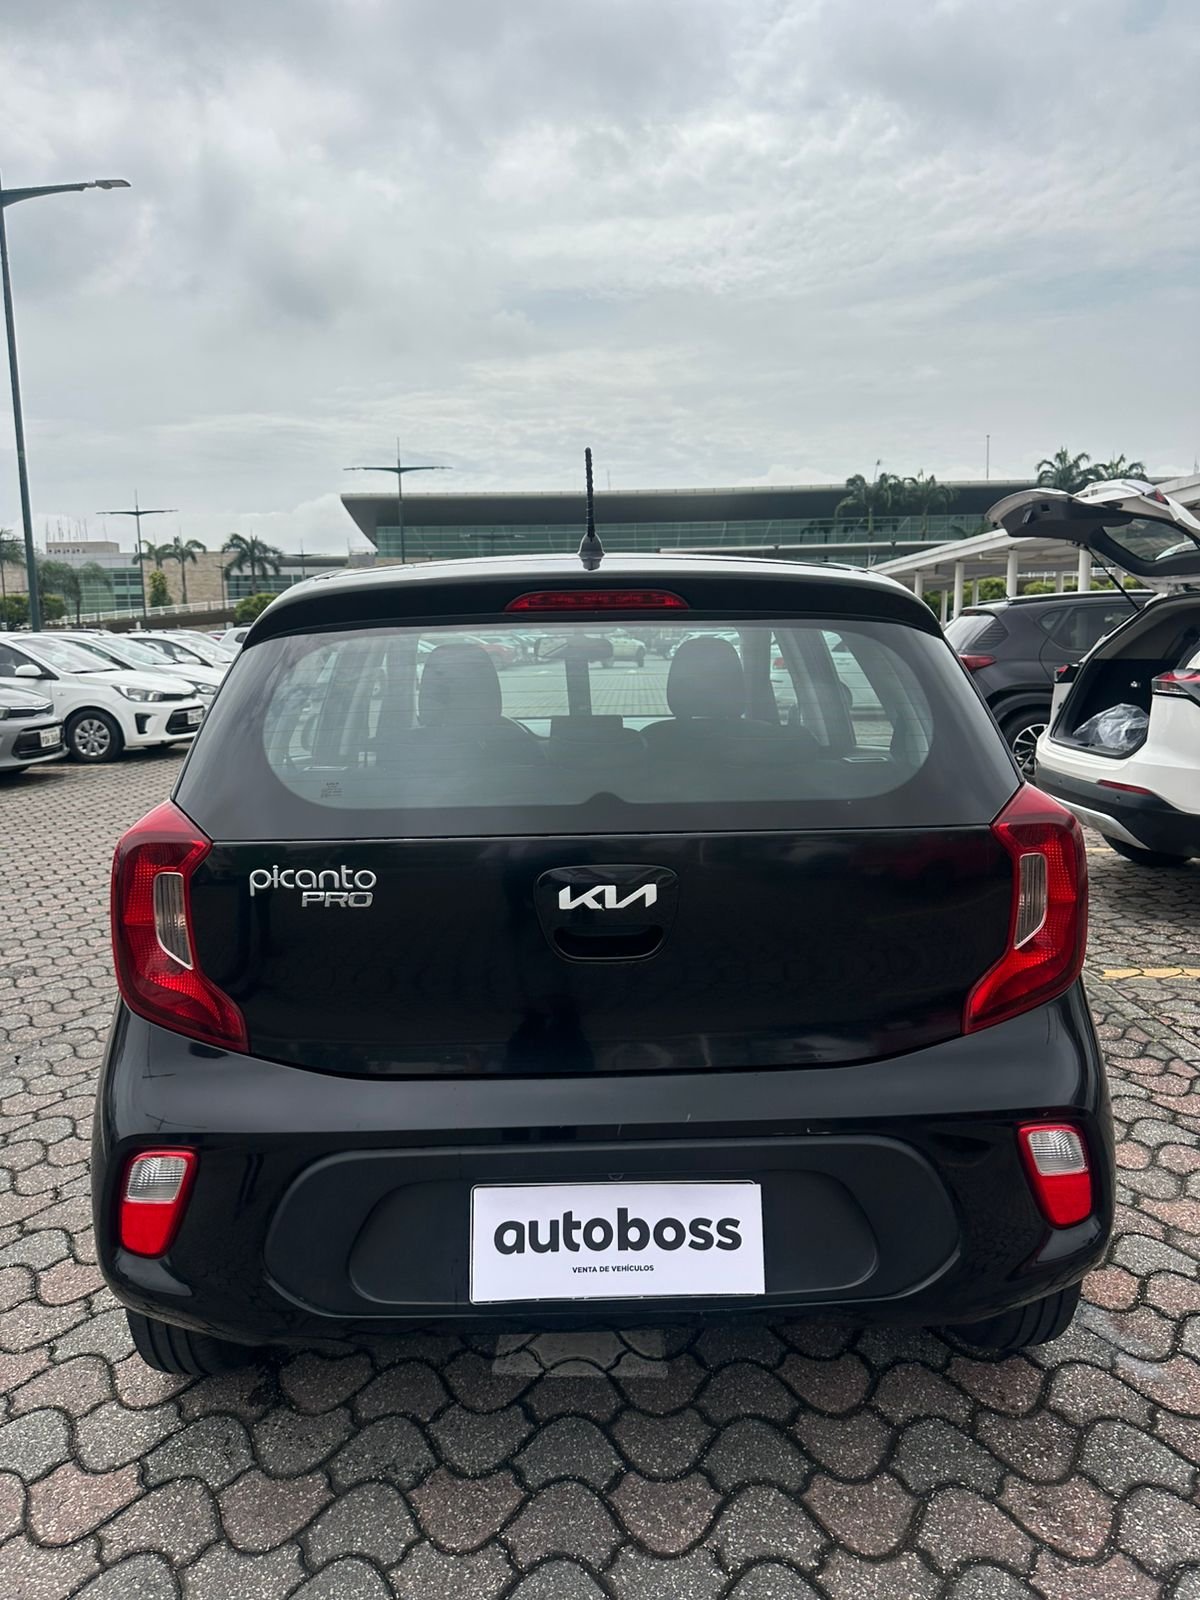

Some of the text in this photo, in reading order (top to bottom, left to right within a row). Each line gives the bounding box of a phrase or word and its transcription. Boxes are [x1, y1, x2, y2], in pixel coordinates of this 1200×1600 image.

[249, 864, 377, 897] picanto
[301, 891, 374, 908] PRO
[558, 883, 657, 910] KIA
[493, 1207, 743, 1255] autoboss
[572, 1263, 654, 1274] VENTA DE VEHÍCULOS
